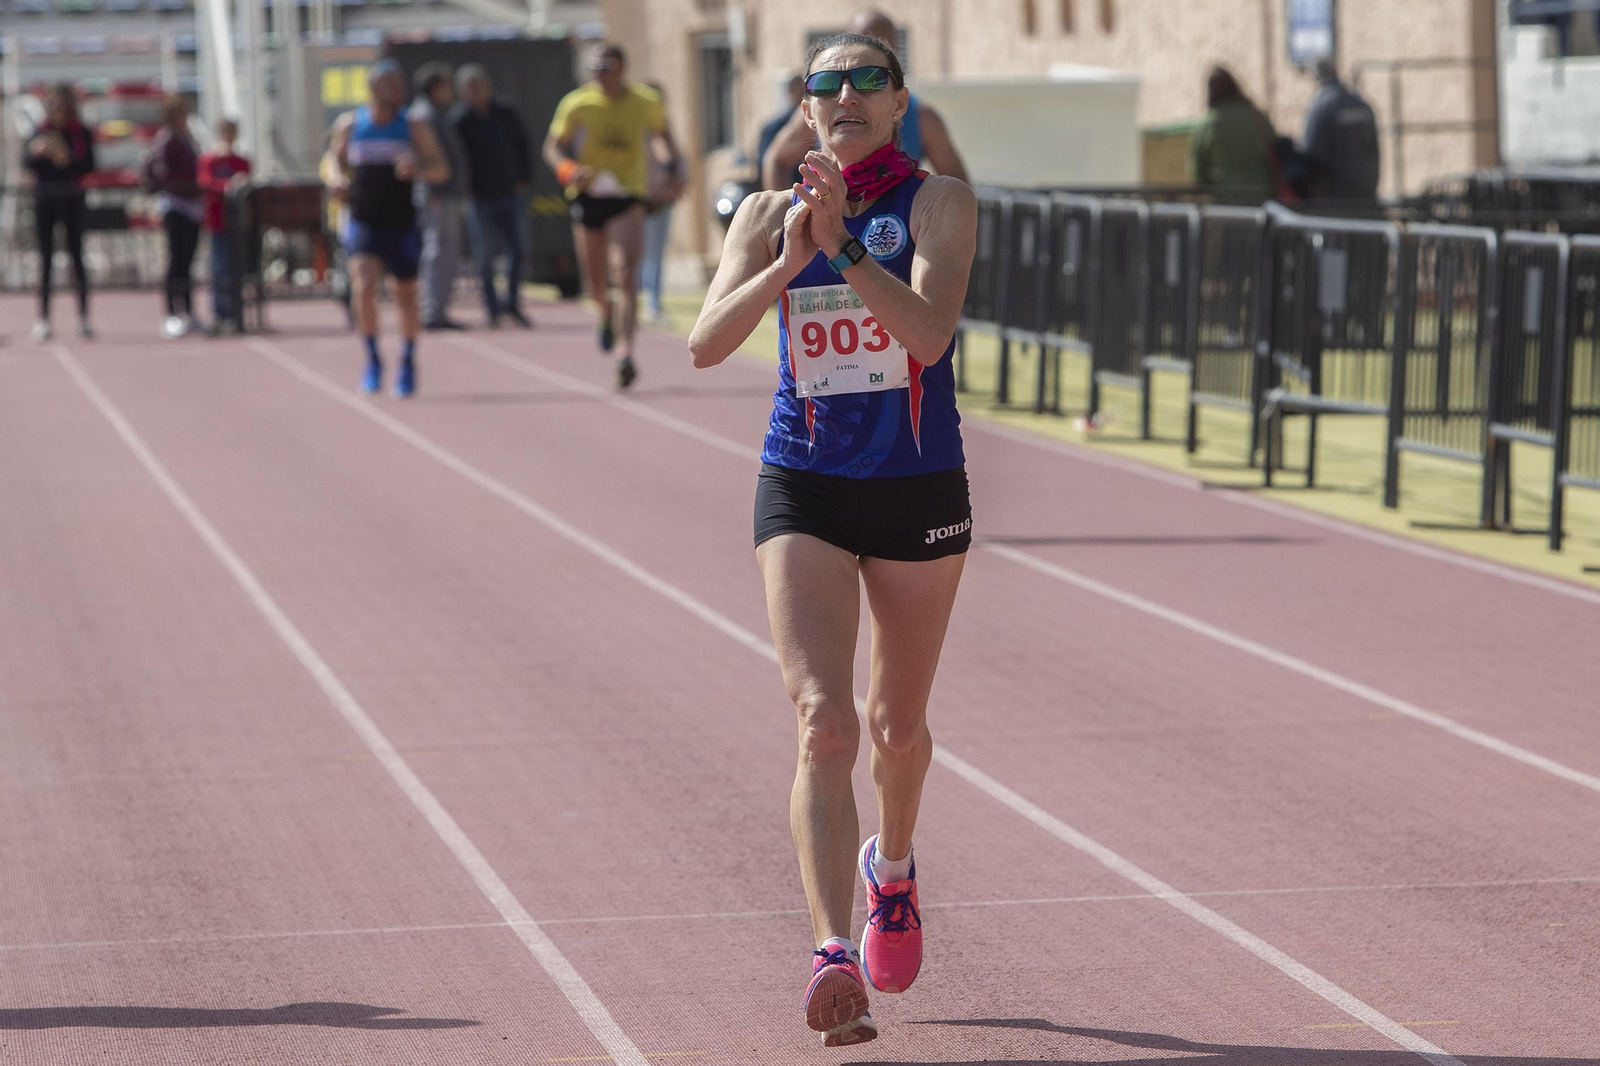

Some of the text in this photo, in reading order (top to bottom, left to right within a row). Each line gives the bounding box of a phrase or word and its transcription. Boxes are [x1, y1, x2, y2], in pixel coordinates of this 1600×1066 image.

[821, 290, 845, 298] MEDIA
[799, 299, 832, 313] BAHÍA
[835, 299, 850, 310] DE
[801, 316, 891, 359] 903
[869, 372, 884, 383] Dd
[925, 518, 970, 544] Joma
